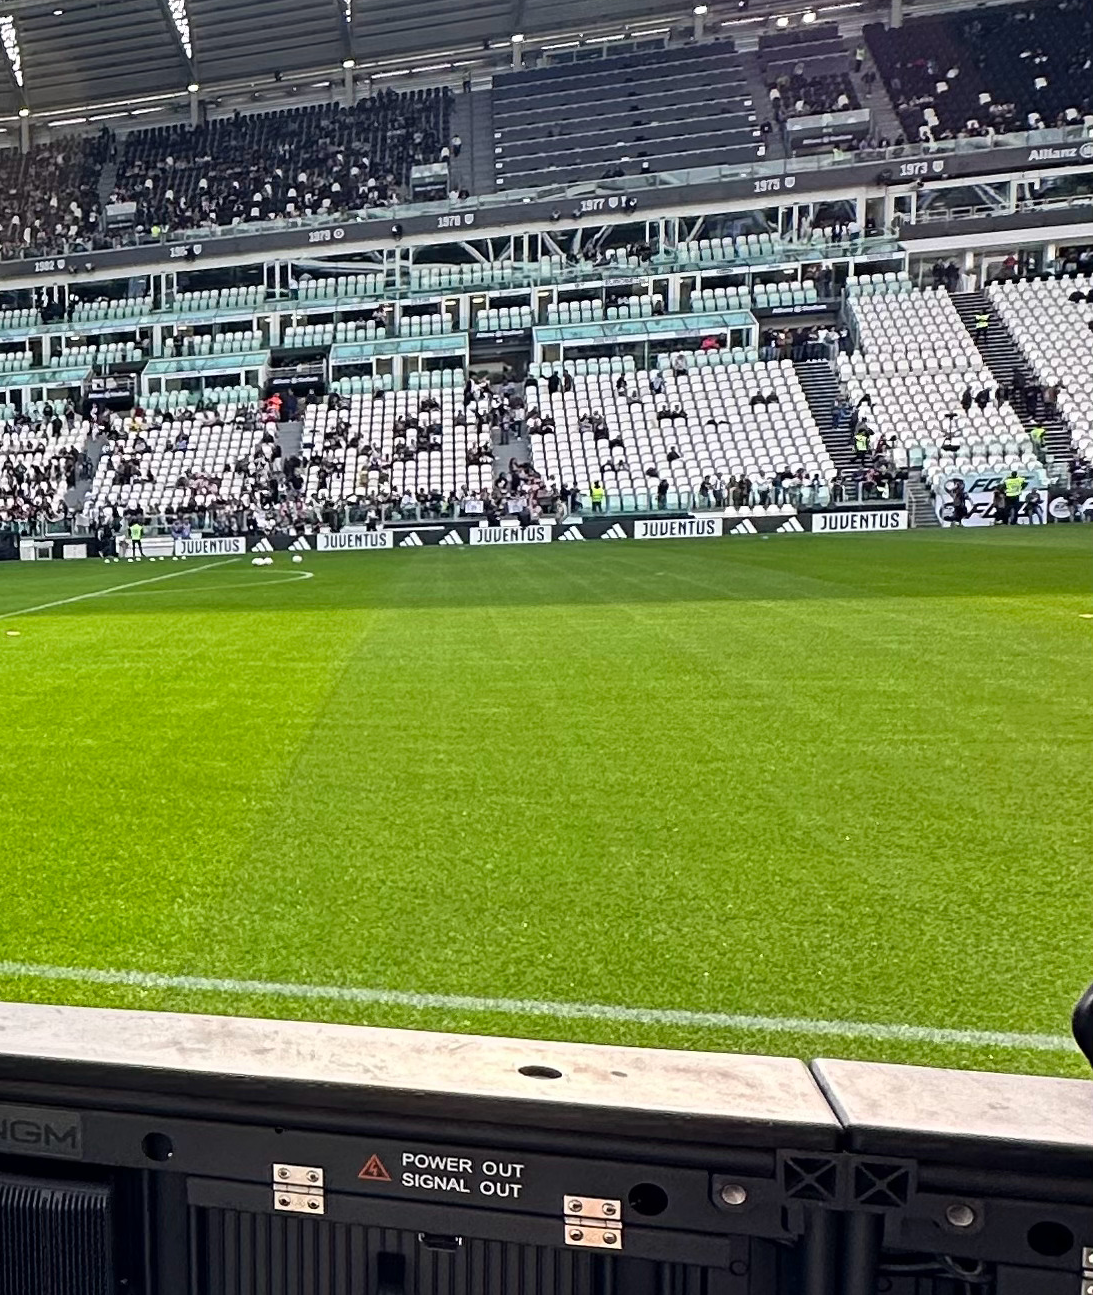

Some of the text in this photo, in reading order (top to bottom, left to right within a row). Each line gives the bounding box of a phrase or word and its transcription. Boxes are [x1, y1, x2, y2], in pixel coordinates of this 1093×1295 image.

[1028, 148, 1077, 162] Allianz
[899, 162, 928, 177] 1973
[754, 178, 780, 193] 1975
[580, 198, 606, 211] 1977
[642, 520, 715, 538] JUVENTUS
[820, 513, 900, 530] JUVENTUS
[323, 533, 387, 549] JUVENTUS
[476, 527, 545, 543] JUVENTUS
[180, 539, 240, 554] JUVENTUS
[401, 1152, 525, 1179] POWER OUT
[401, 1172, 523, 1198] SIGNAL OUT
